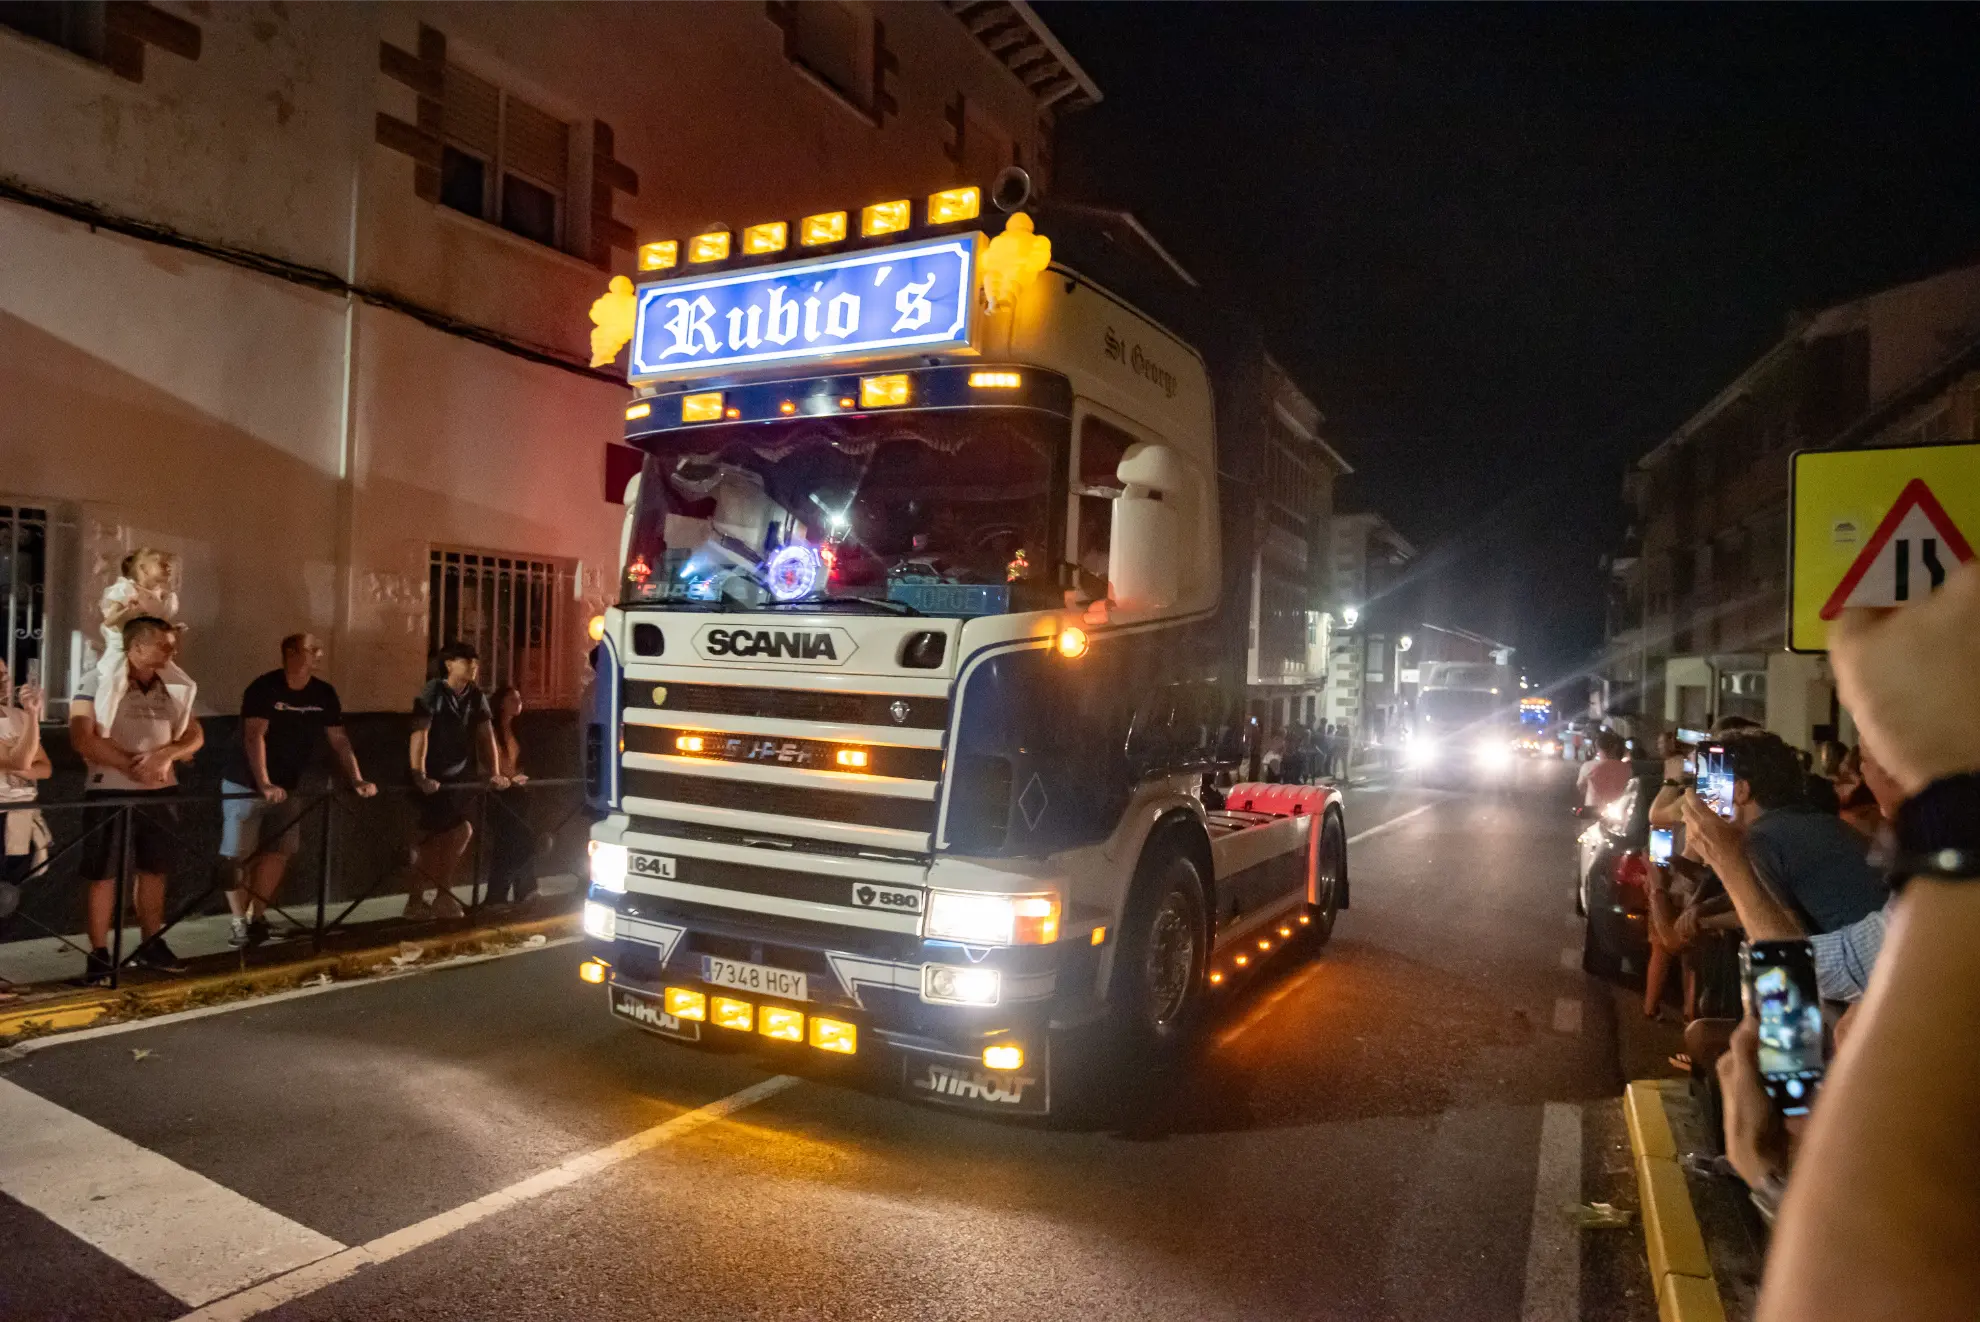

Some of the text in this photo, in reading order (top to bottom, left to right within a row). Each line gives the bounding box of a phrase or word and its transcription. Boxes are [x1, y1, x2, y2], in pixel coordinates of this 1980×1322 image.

[706, 629, 838, 660] SCANIA
[879, 891, 919, 908] 580
[714, 961, 801, 996] 7348 HGY
